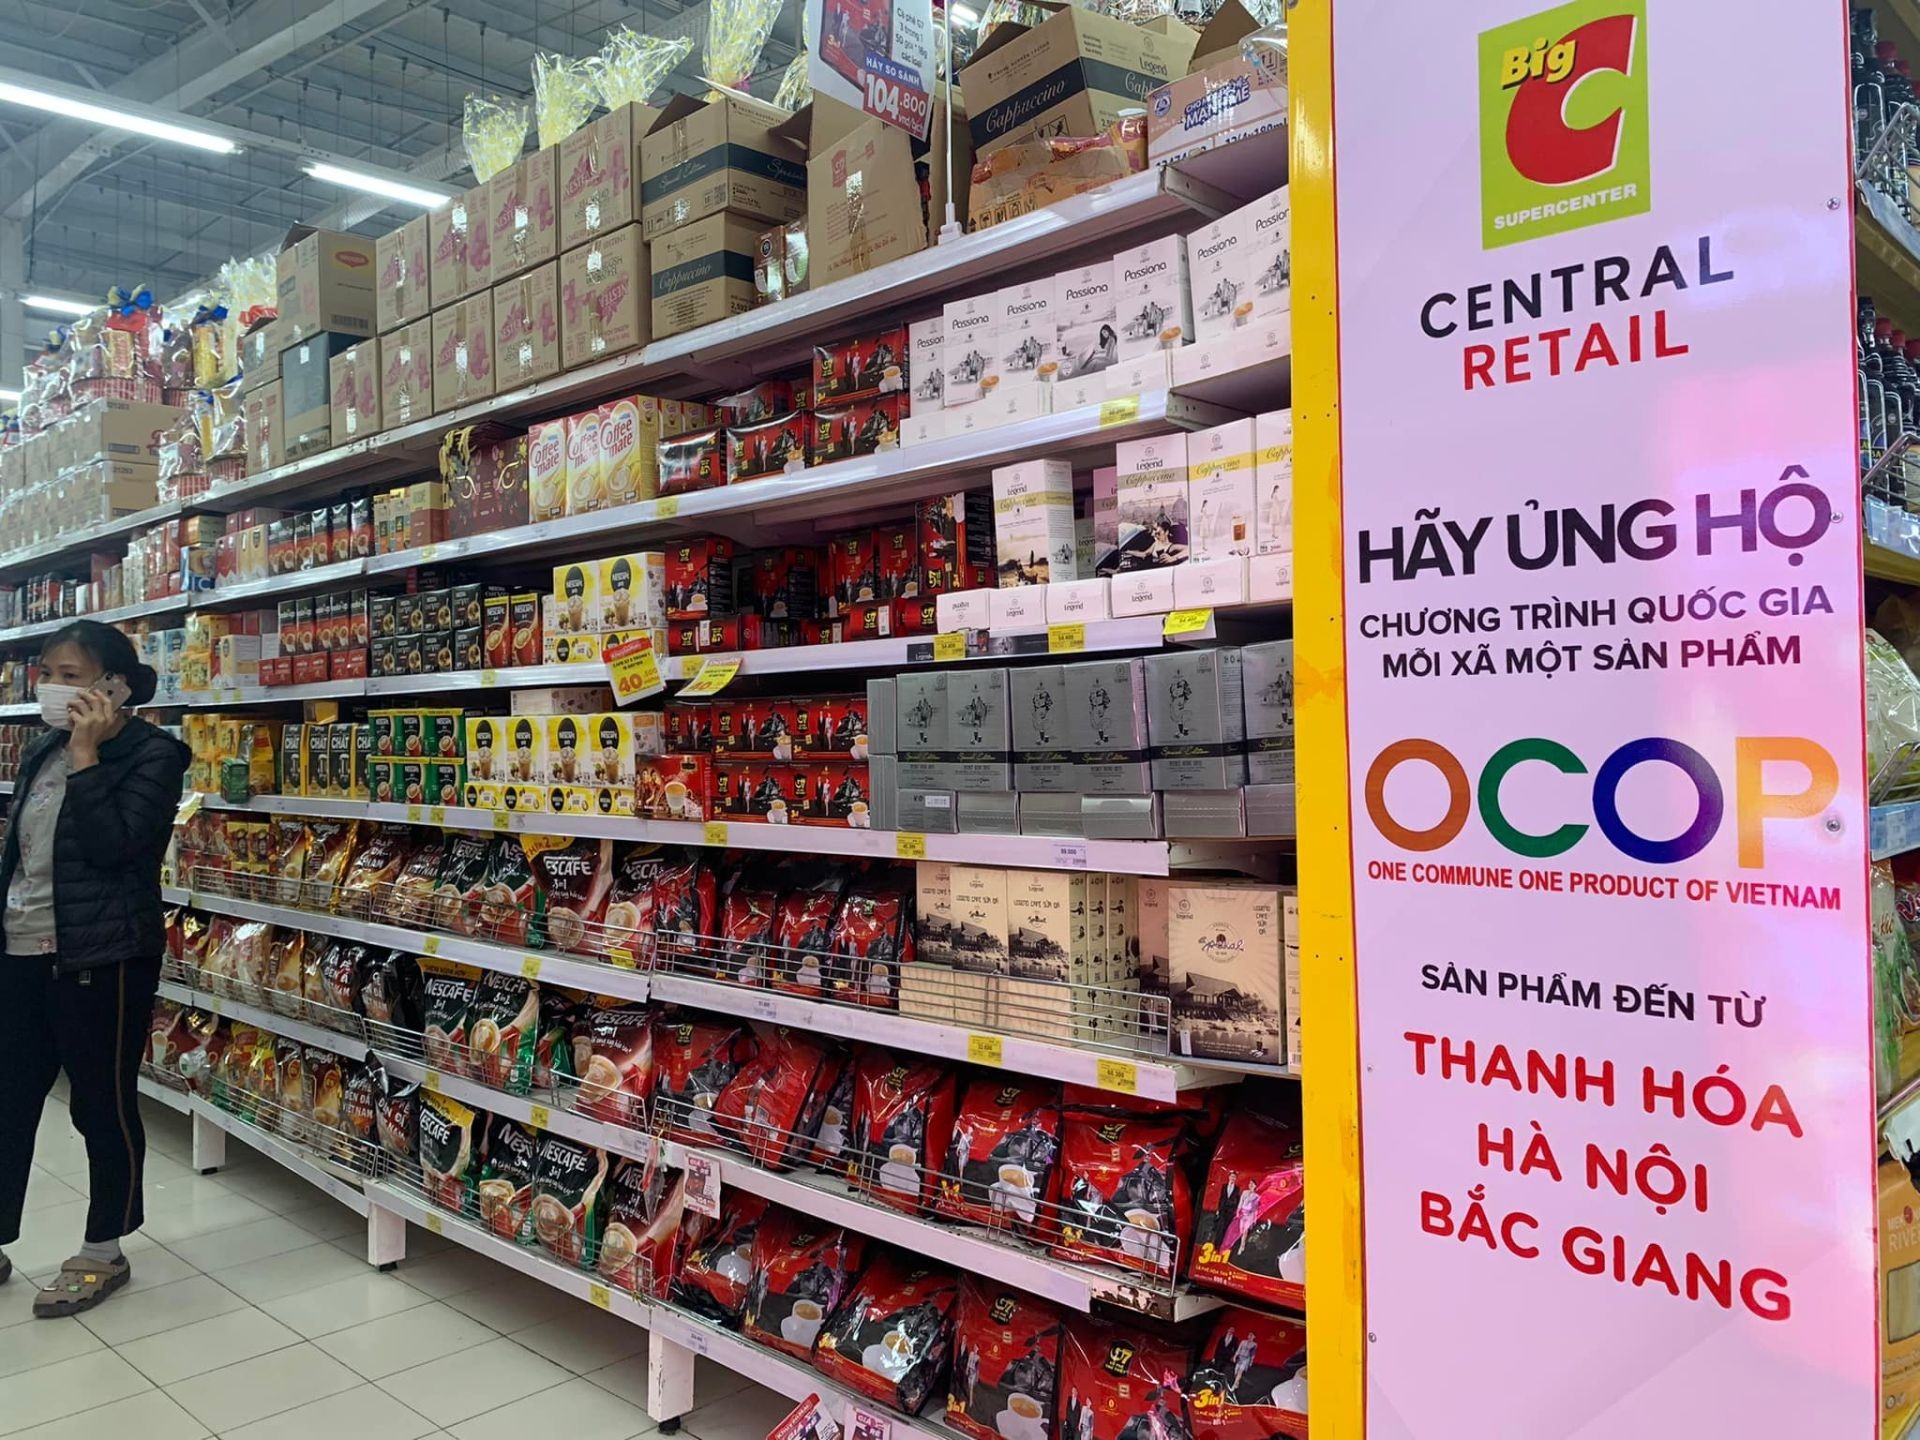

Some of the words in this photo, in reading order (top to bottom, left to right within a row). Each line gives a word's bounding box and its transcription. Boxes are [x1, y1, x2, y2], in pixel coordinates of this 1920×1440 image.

[885, 64, 896, 77] SO
[1139, 56, 1168, 76] Legend
[1501, 37, 1577, 90] Big
[985, 78, 1065, 134] Cappuccino
[1505, 14, 1638, 187] C
[1493, 182, 1638, 230] SUPERCENTER
[1255, 208, 1290, 232] Passion
[1197, 234, 1237, 260] Passiona
[1124, 260, 1168, 283] Passiona
[1065, 282, 1109, 301] Passiona
[1420, 236, 1735, 339] CENTRAL
[1007, 299, 1048, 316] Passiona
[951, 313, 990, 331] Passiona
[916, 335, 945, 350] Passion
[1463, 309, 1690, 390] RETAIL
[600, 418, 632, 451] Coffee
[608, 431, 634, 457] mate
[530, 439, 559, 469] Coffee
[536, 452, 560, 477] mate
[1136, 459, 1165, 471] Legend
[1006, 484, 1028, 497] Legend
[1359, 507, 1494, 584] HÃY
[1506, 499, 1678, 572] ỦNG
[1695, 464, 1832, 568] HỘ
[1063, 601, 1084, 612] Legend
[1132, 592, 1153, 603] Legend
[1006, 608, 1025, 617] Legend
[1360, 607, 1501, 638] CHƯƠNG
[1511, 596, 1617, 631] TRÌNH
[1628, 585, 1747, 624] QUỐC
[1758, 584, 1835, 617] GIA
[1382, 647, 1441, 679] MỖI
[1451, 643, 1497, 677] XÃ
[1505, 640, 1582, 680] MỘT
[1593, 637, 1668, 670] SẢN
[1680, 630, 1802, 669] PHẨM
[1364, 737, 1840, 869] OCOP
[1368, 860, 1407, 882] ONE
[1411, 864, 1513, 890] COMMUNE
[1519, 869, 1564, 893] ONE
[1569, 873, 1680, 900] PRODUCT
[1686, 878, 1719, 902] OF
[1725, 881, 1841, 911] VIETNAM
[1421, 963, 1487, 996] SẢN
[1498, 970, 1601, 1010] PHẨM
[1613, 982, 1695, 1022] ĐẾN
[1707, 990, 1766, 1028] TỪ
[1404, 1032, 1615, 1106] THANH
[1643, 1063, 1803, 1139] HÓA
[1477, 1120, 1563, 1183] HÀ
[1585, 1143, 1708, 1216] NỘI
[1198, 1242, 1232, 1264] 3in1
[1420, 1183, 1540, 1259] BẮC
[1561, 1226, 1791, 1321] GIANG
[1193, 1388, 1226, 1409] 3in1
